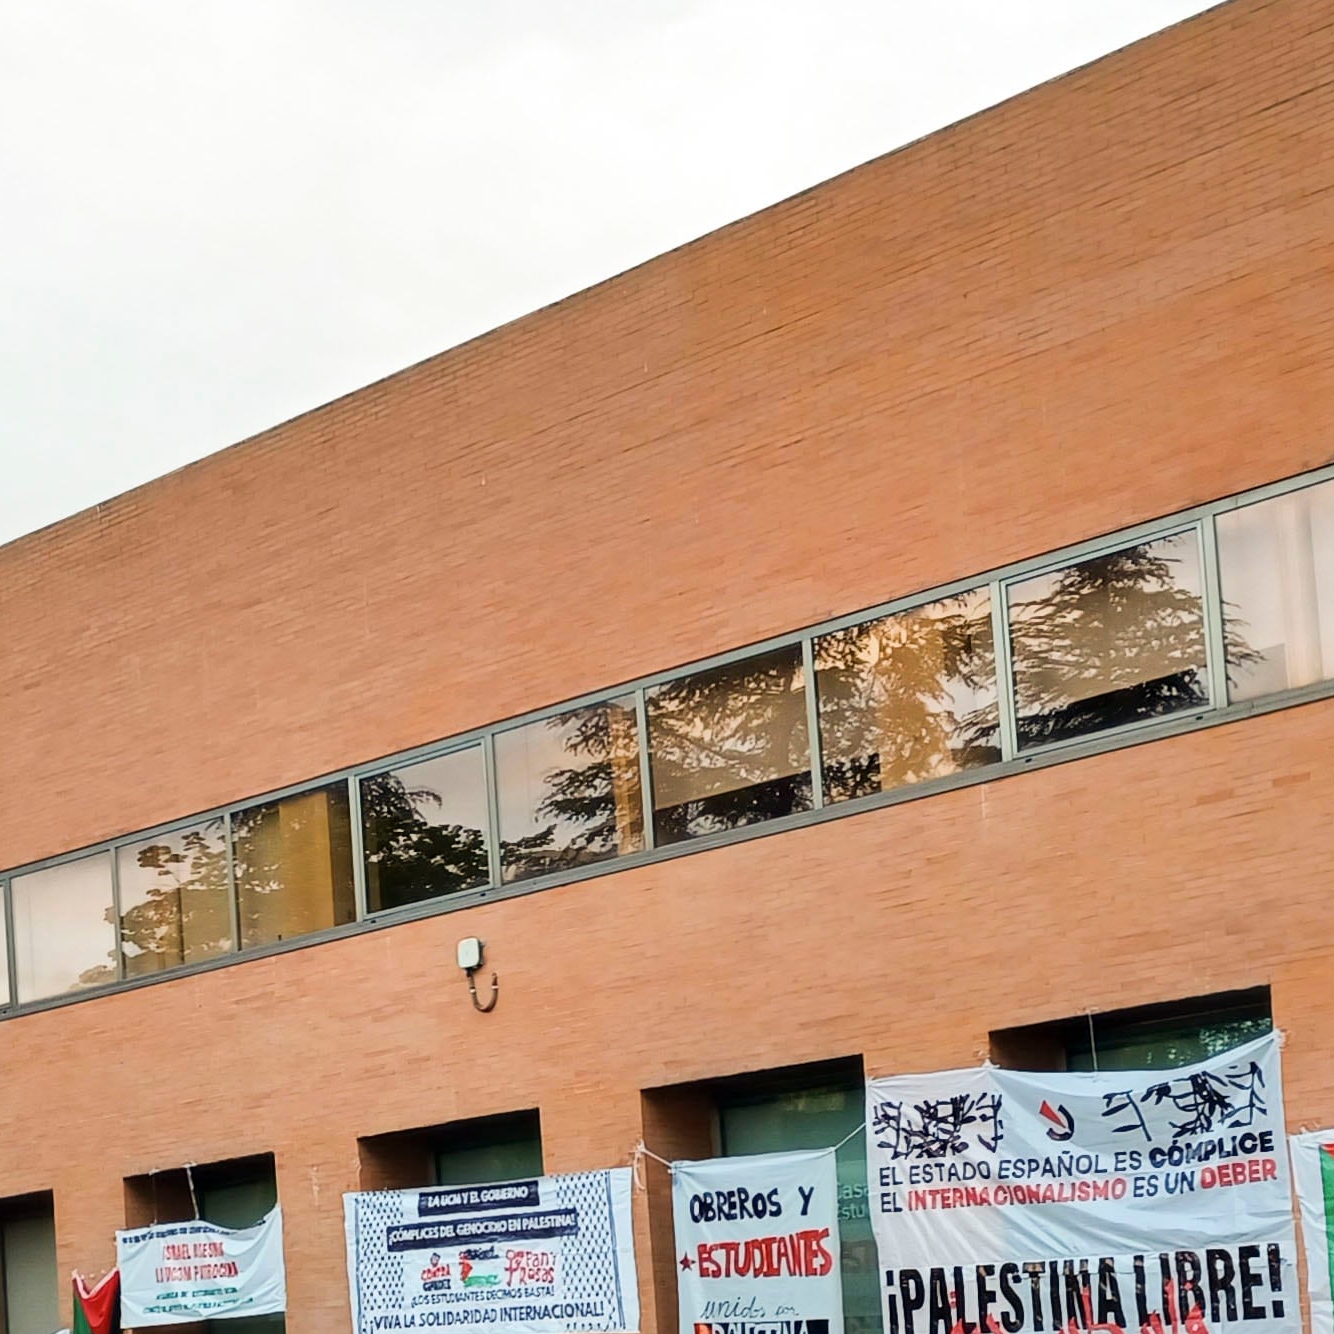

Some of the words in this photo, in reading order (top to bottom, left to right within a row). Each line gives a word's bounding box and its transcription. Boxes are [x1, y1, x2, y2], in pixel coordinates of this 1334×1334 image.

[880, 1167, 903, 1186] EL
[909, 1161, 991, 1184] ESTADO
[998, 1150, 1107, 1179] ESPAÑOL
[1114, 1150, 1142, 1171] ES
[1149, 1130, 1275, 1168] CÓMPLICE
[689, 1187, 783, 1223] OBREROS
[798, 1186, 815, 1217] Y
[881, 1192, 903, 1213] EL
[908, 1177, 1127, 1211] INTERNACIONALISMO
[1133, 1175, 1159, 1198] ES
[1164, 1171, 1195, 1194] UN
[1200, 1159, 1277, 1189] DEBER
[439, 1225, 455, 1238] DEL
[456, 1220, 508, 1236] GENOCIDIO
[509, 1218, 521, 1232] EN
[522, 1214, 576, 1230] PALESTINA!
[697, 1228, 833, 1278] ESTUDIANTES
[430, 1291, 485, 1305] ESTUDIANTES
[486, 1288, 523, 1299] DECIMOS
[1133, 1244, 1285, 1332] LIBRE!
[370, 1313, 401, 1334] ¡VIVA
[404, 1314, 416, 1328] LA
[418, 1307, 498, 1327] SOLIDARIDAD
[500, 1301, 605, 1322] INTERNACIONAL!
